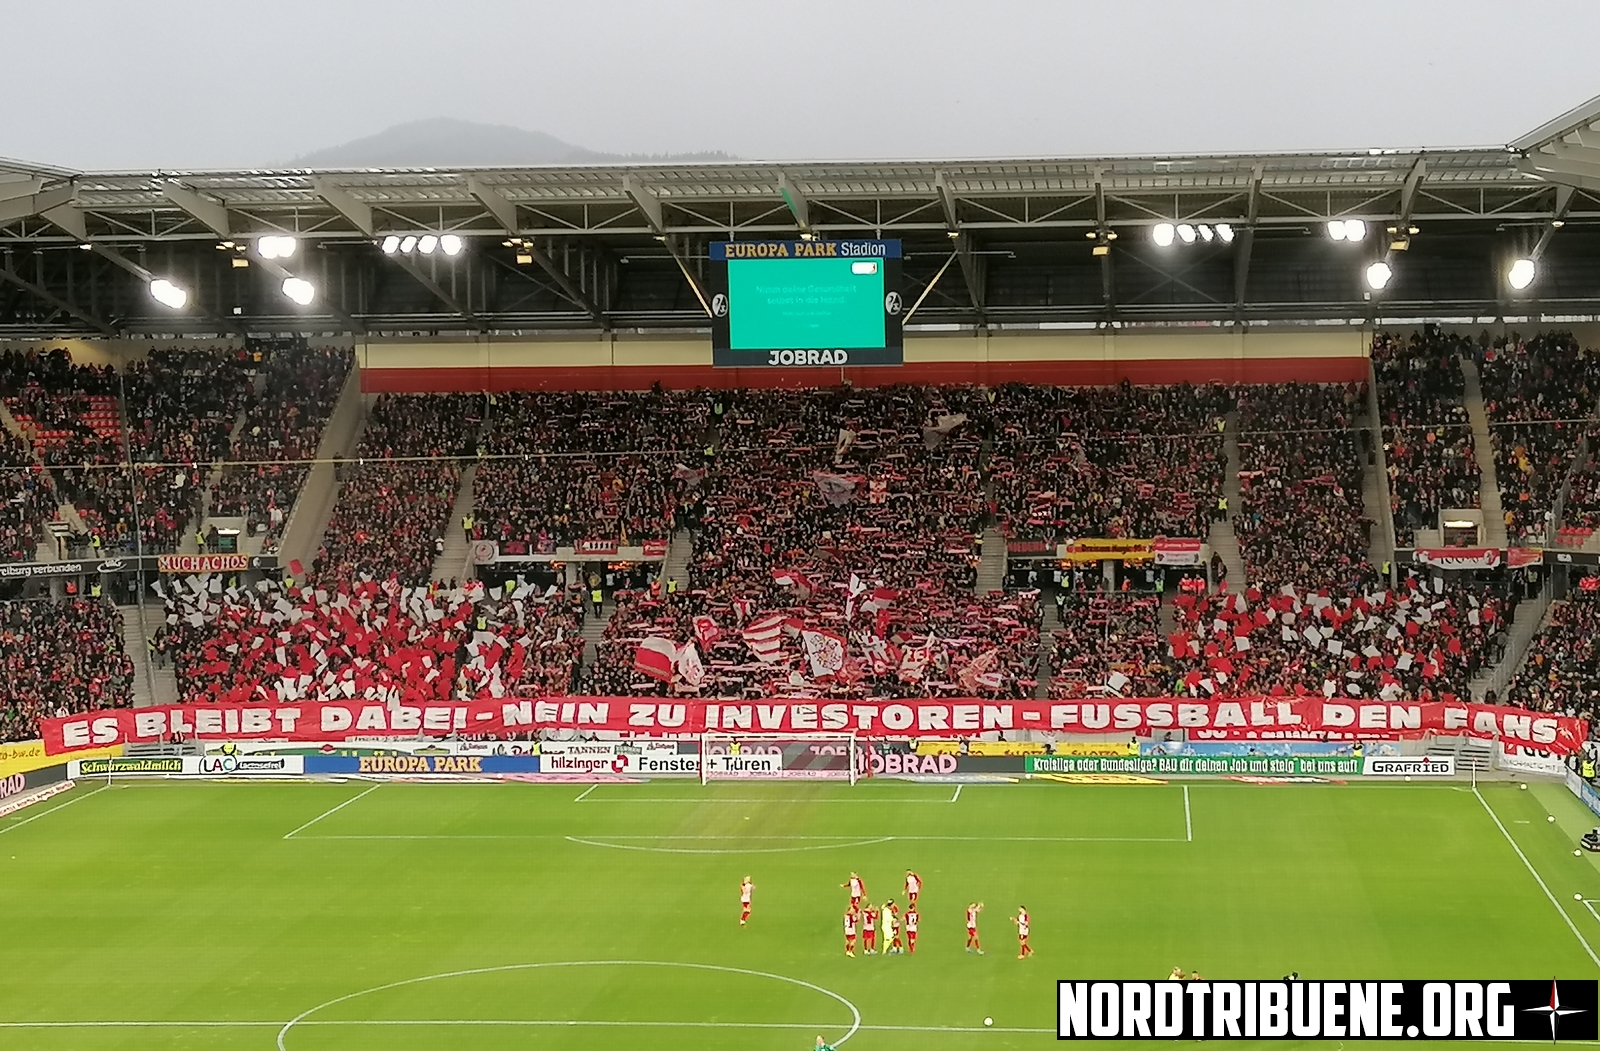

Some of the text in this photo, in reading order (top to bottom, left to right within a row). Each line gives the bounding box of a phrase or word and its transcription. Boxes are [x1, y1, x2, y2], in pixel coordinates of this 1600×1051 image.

[725, 242, 886, 258] EUROPA PARK Stadion
[768, 349, 848, 366] JOBRAD
[33, 563, 82, 575] verbunden
[160, 556, 248, 572] MUCHACHOS
[62, 717, 119, 748] ES
[136, 707, 301, 737] BLEIBT
[320, 705, 467, 732] DABEI
[502, 701, 611, 726] NEIN
[628, 703, 687, 727] ZU
[705, 703, 1013, 731] INVESTOREN
[1051, 702, 1302, 729] FUSSBALL
[1322, 704, 1421, 729] DEN
[1444, 706, 1558, 744] FANS
[567, 746, 611, 754] TANNEN
[81, 759, 182, 773] Schwarzwaldmilch
[204, 758, 233, 772] LAC
[359, 756, 483, 772] EUROPA PARK
[551, 756, 609, 773] hilzinger
[639, 757, 700, 771] Fenster
[722, 757, 771, 771] Türen
[856, 754, 958, 774] JOBRAD
[1077, 758, 1099, 772] oder
[1101, 757, 1156, 773] Bundesliga?
[1159, 758, 1177, 772] BAU
[1180, 757, 1193, 772] dir
[1195, 758, 1228, 773] deinen
[1230, 758, 1247, 773] Job
[1250, 758, 1268, 773] und
[1300, 758, 1316, 773] bei
[1318, 760, 1336, 773] uns
[1372, 760, 1450, 773] GRAFRIED
